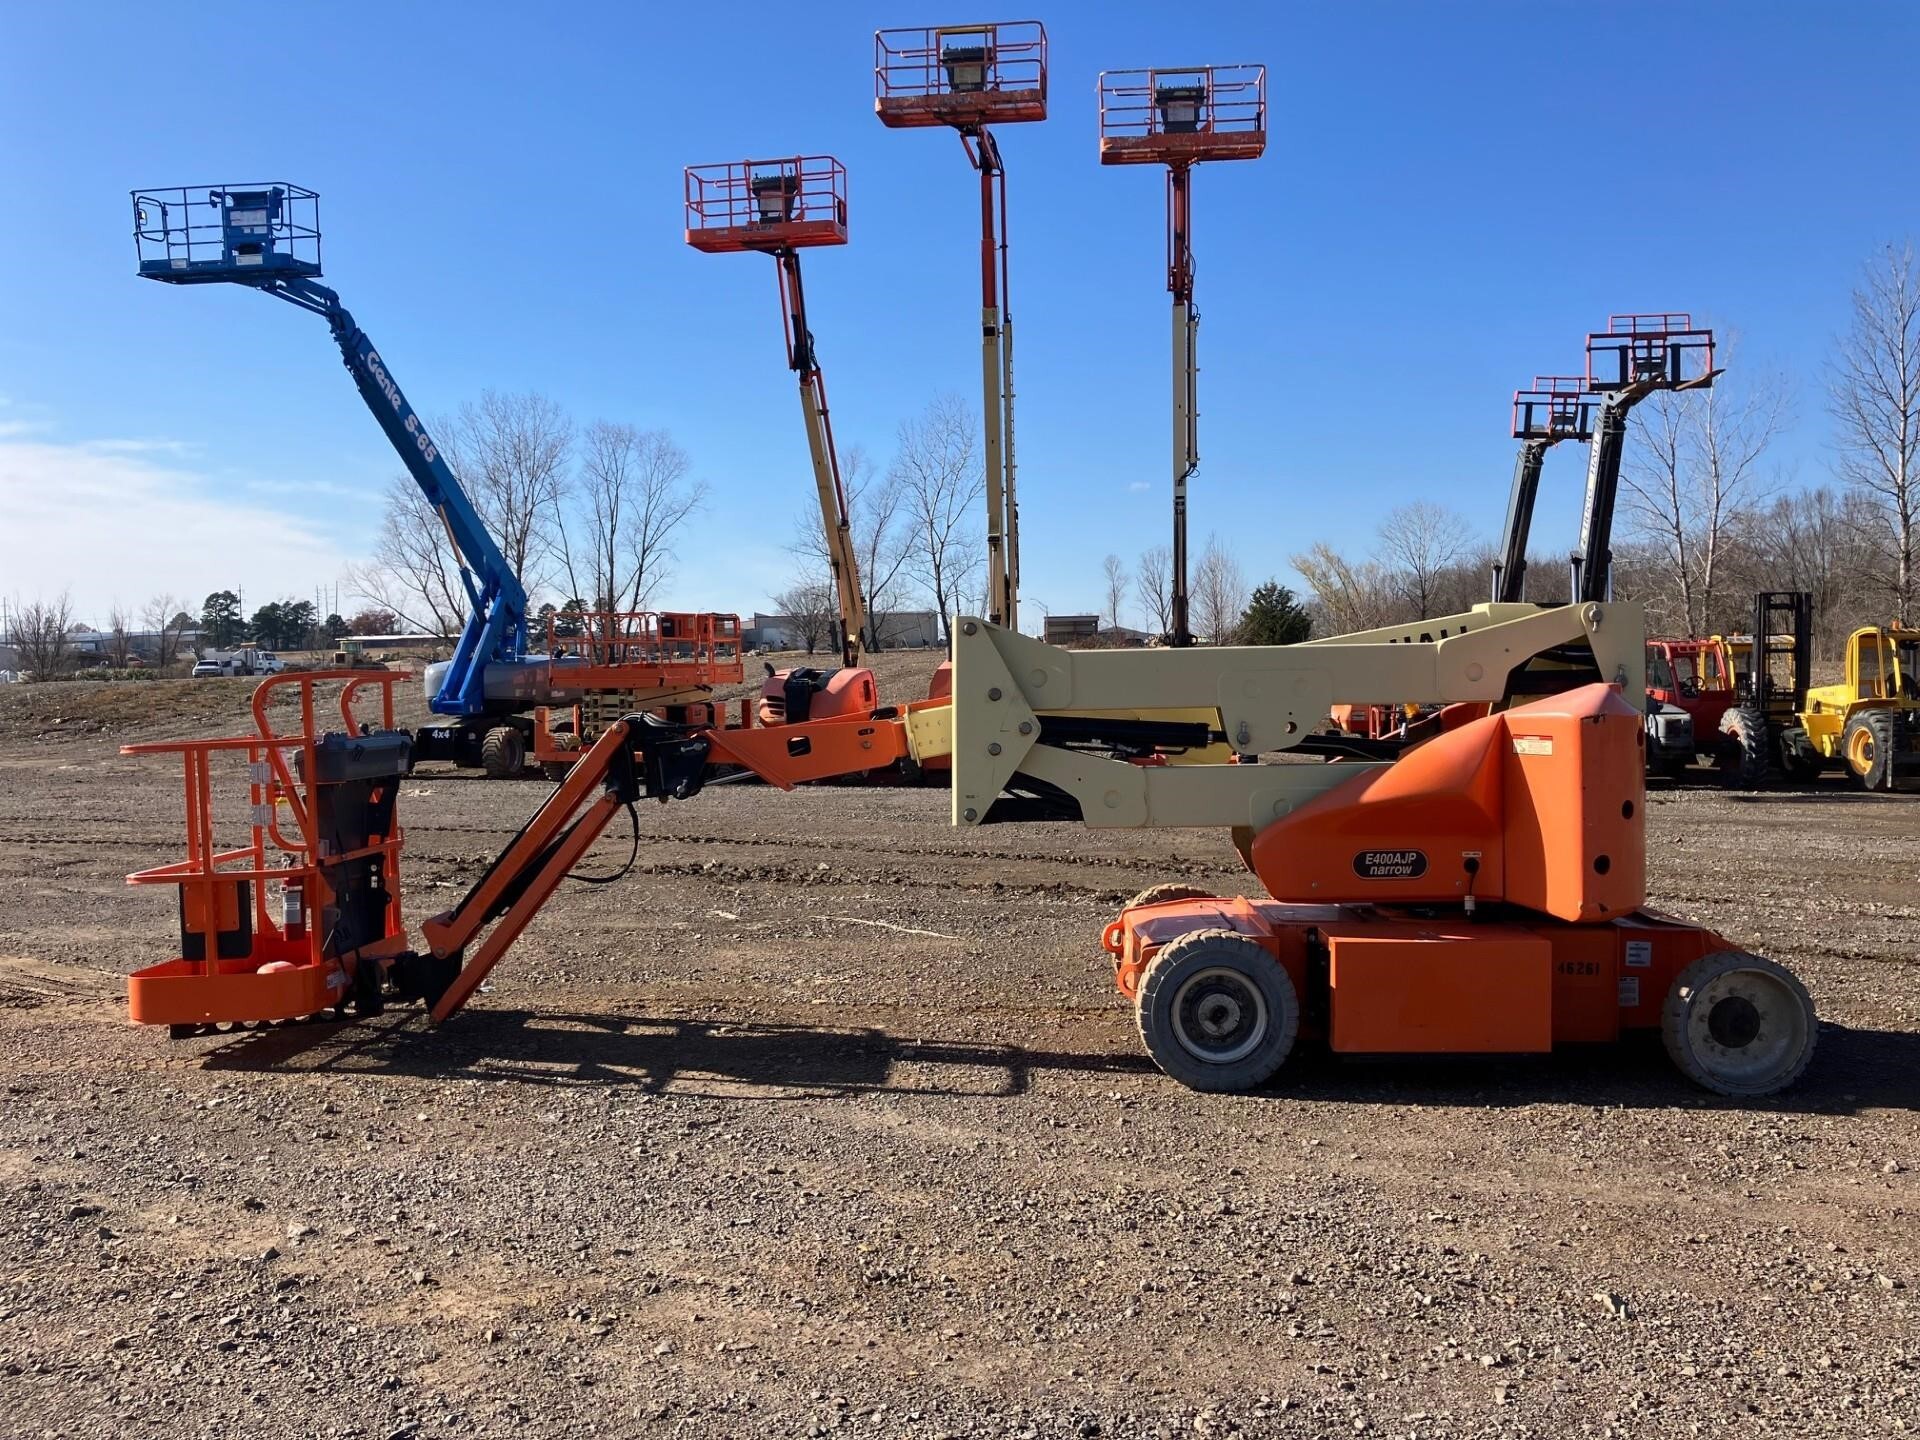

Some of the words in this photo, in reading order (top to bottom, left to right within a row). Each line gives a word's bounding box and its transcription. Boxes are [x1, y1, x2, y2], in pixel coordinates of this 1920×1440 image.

[367, 351, 402, 412] Genie
[405, 414, 437, 463] S-65
[431, 729, 451, 739] 4x4
[1365, 852, 1417, 865] E400AJP
[1370, 865, 1413, 875] narrow
[1557, 961, 1600, 975] 46261
